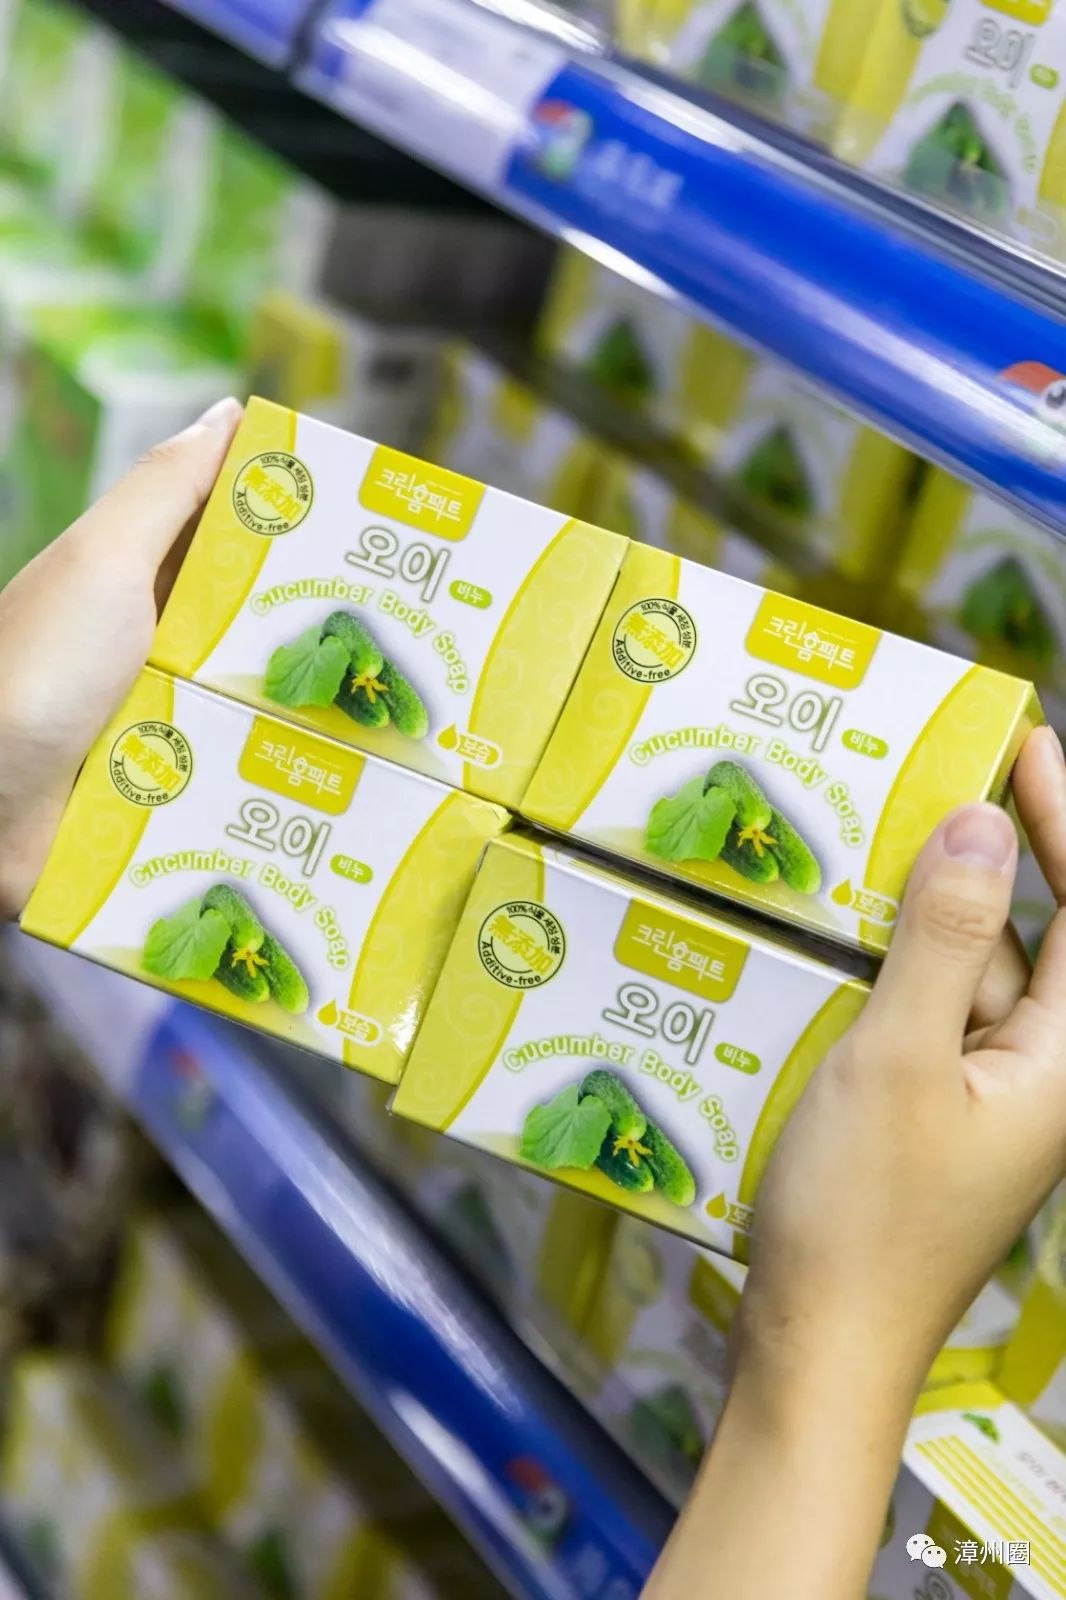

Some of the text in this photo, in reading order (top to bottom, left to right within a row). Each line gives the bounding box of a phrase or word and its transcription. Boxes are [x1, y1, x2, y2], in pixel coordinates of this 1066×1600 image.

[236, 491, 290, 532] Additive-free
[344, 526, 452, 604] 오이
[456, 582, 484, 605] 비누
[641, 601, 661, 611] 100%
[251, 577, 470, 695] Cucumber Body Soap
[615, 638, 671, 679] Additive-free
[138, 724, 158, 733] 100%
[729, 673, 844, 754] 오이
[849, 731, 879, 755] 비누
[112, 759, 169, 803] Additive-free
[629, 724, 866, 847] Cucumber Body Soap
[225, 798, 333, 879] 오이
[337, 857, 365, 879] 비누
[128, 850, 351, 971] Cucumber Body Soap
[506, 904, 528, 914] 100%
[481, 940, 542, 985] Additive-free
[601, 981, 716, 1067] 오이
[722, 1046, 752, 1069] 비누
[502, 1032, 739, 1163] Cucumber Body Soap
